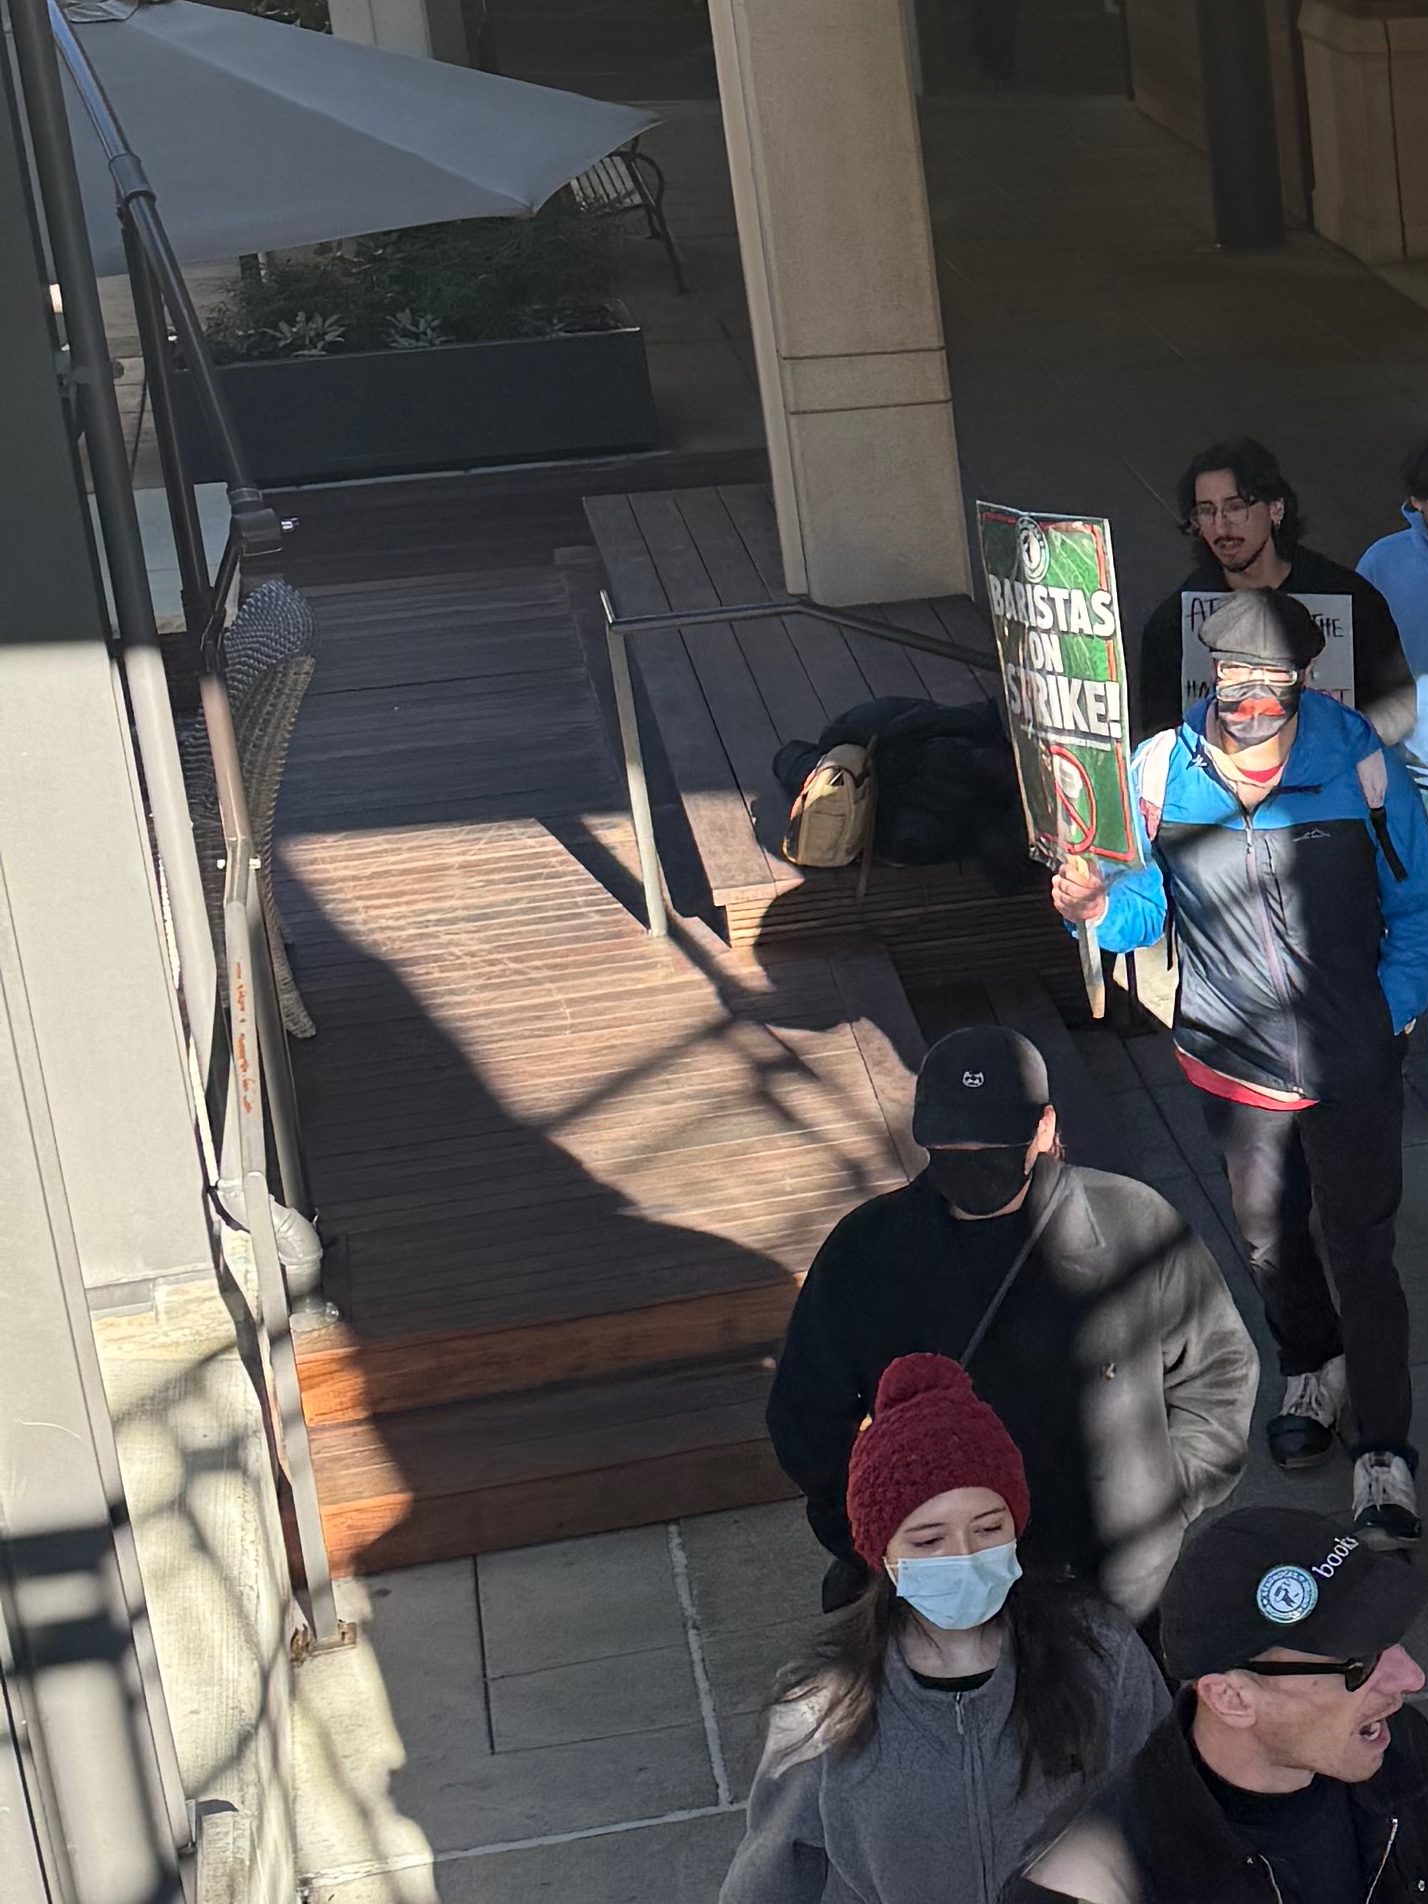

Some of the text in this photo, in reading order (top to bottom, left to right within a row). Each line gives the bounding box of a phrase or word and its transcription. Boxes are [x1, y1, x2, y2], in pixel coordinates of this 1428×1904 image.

[989, 574, 1116, 639] BARISTAS
[1028, 629, 1064, 673] ON
[1006, 663, 1122, 739] STRIKE!
